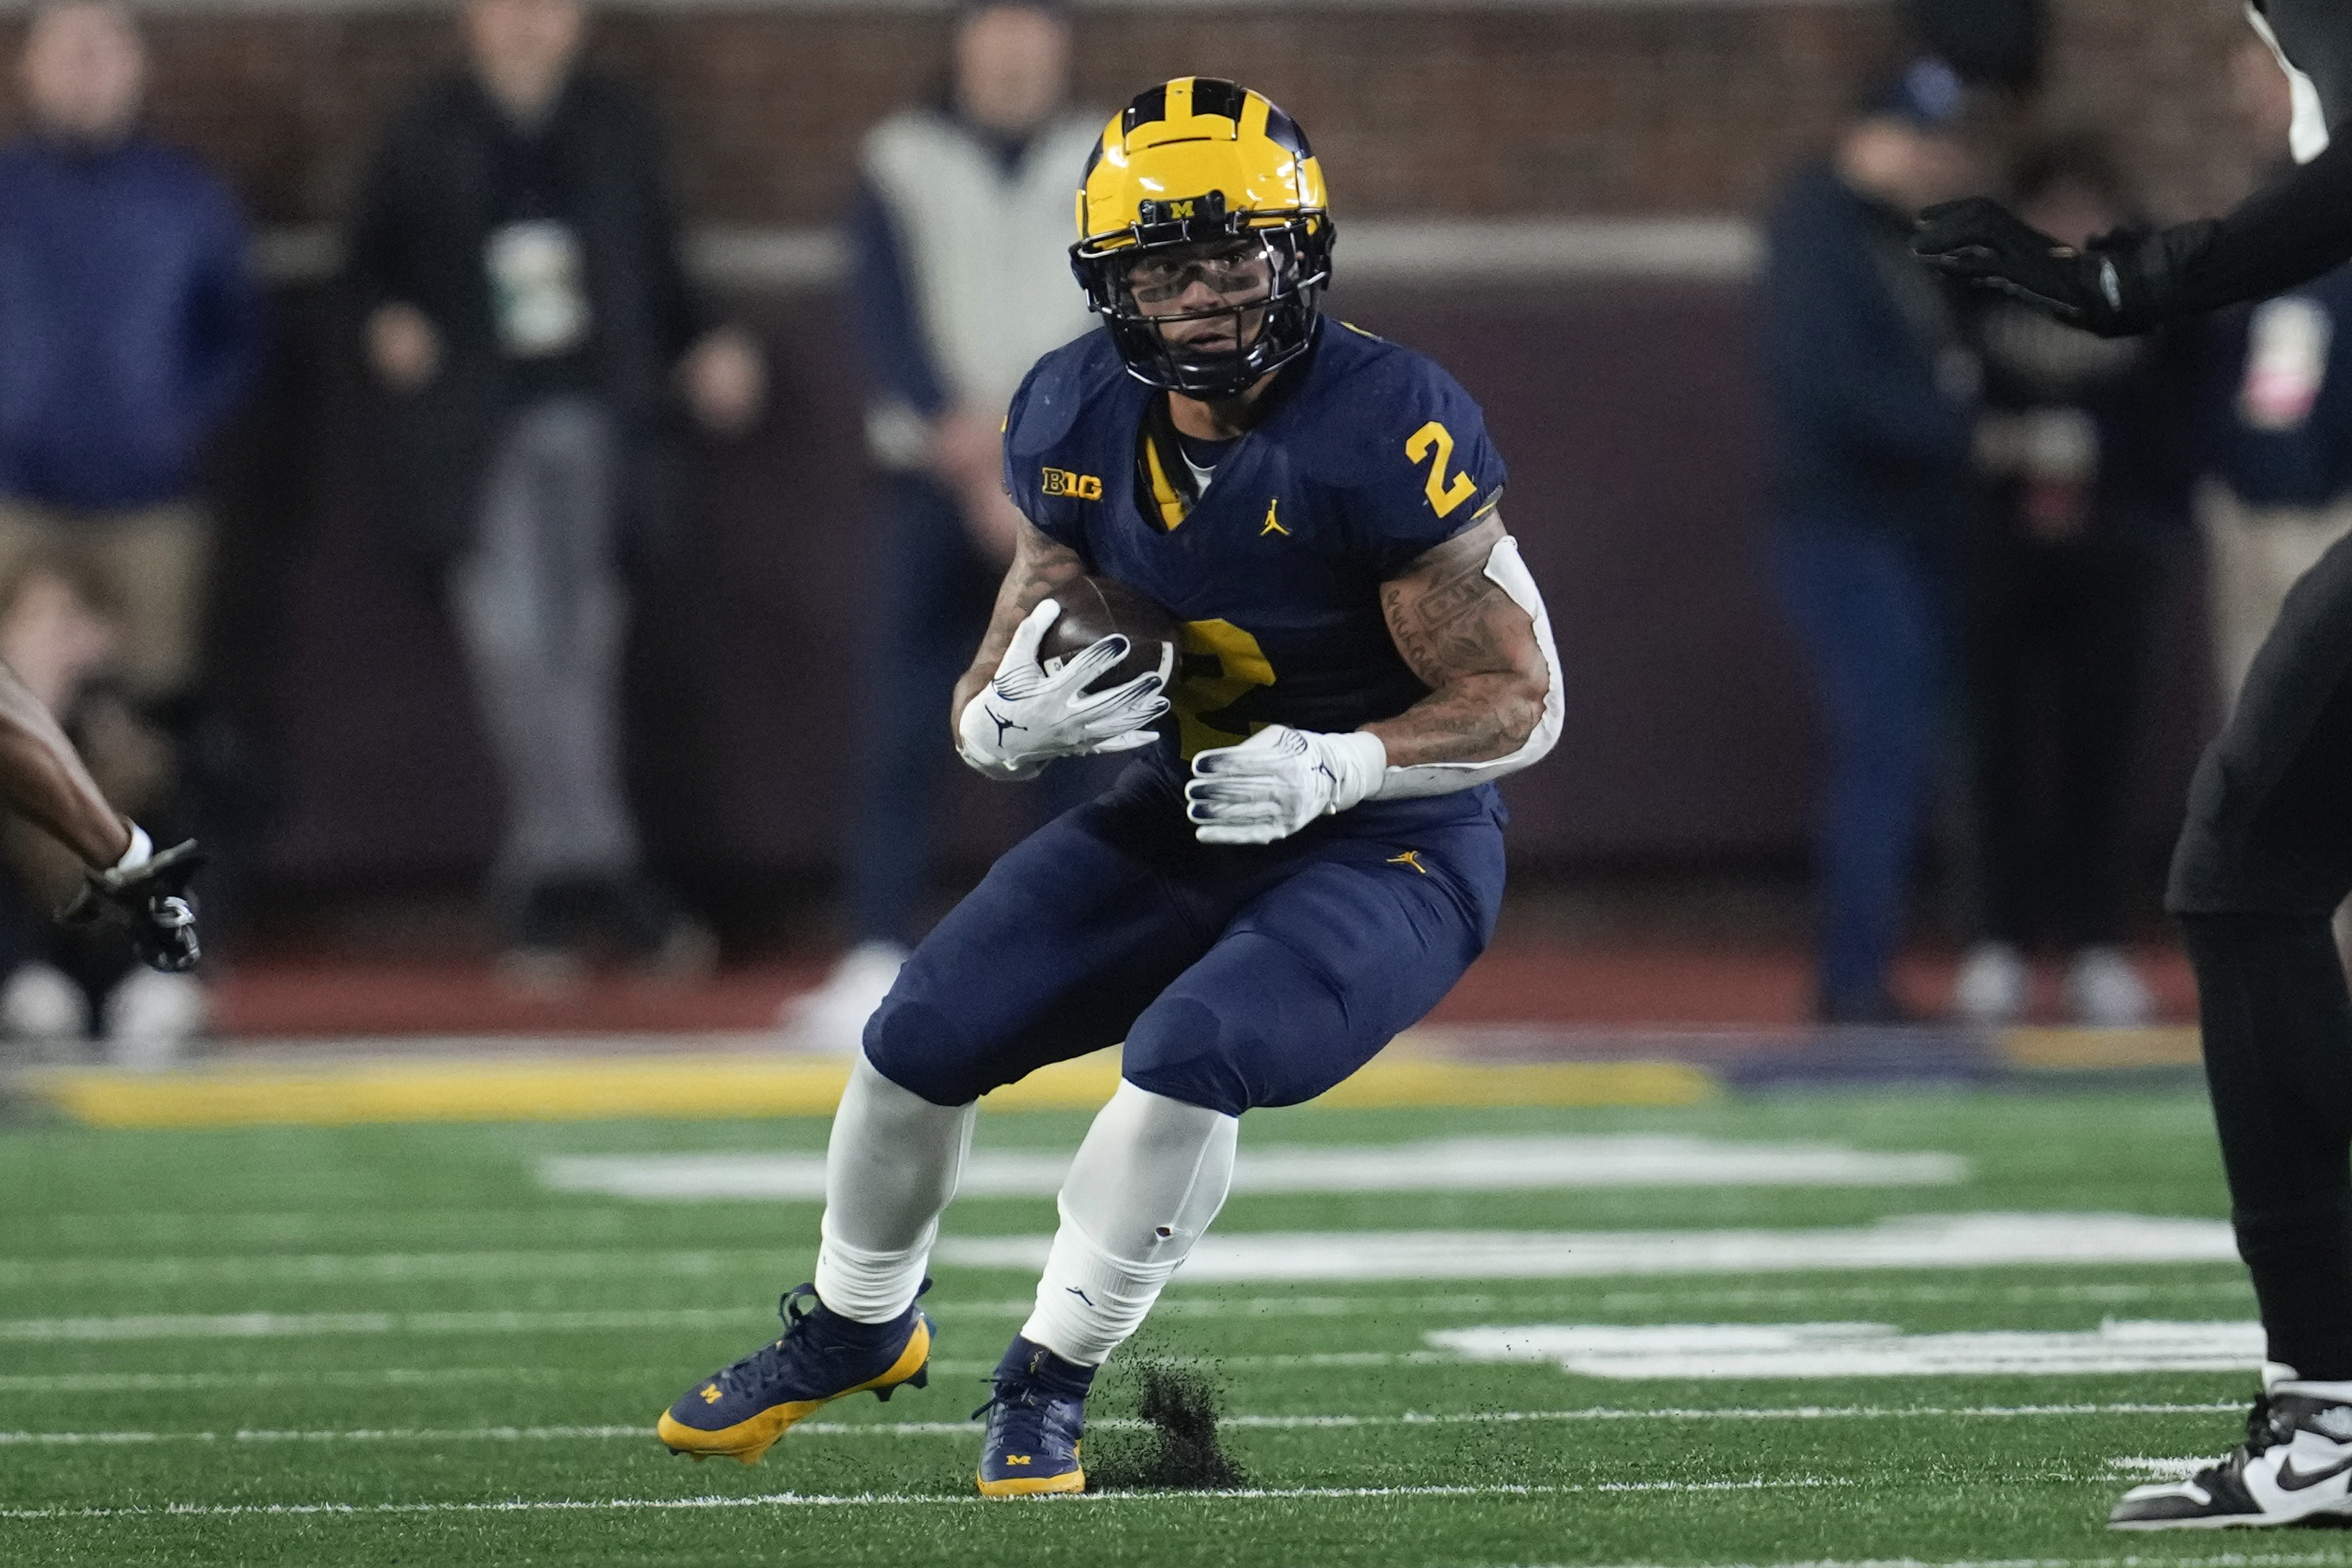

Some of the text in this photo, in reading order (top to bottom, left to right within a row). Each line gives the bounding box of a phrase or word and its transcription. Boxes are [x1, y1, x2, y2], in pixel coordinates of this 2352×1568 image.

[1170, 200, 1195, 219] M
[1405, 421, 1478, 518] 2
[700, 1383, 723, 1404] M
[1006, 1455, 1031, 1465] M
